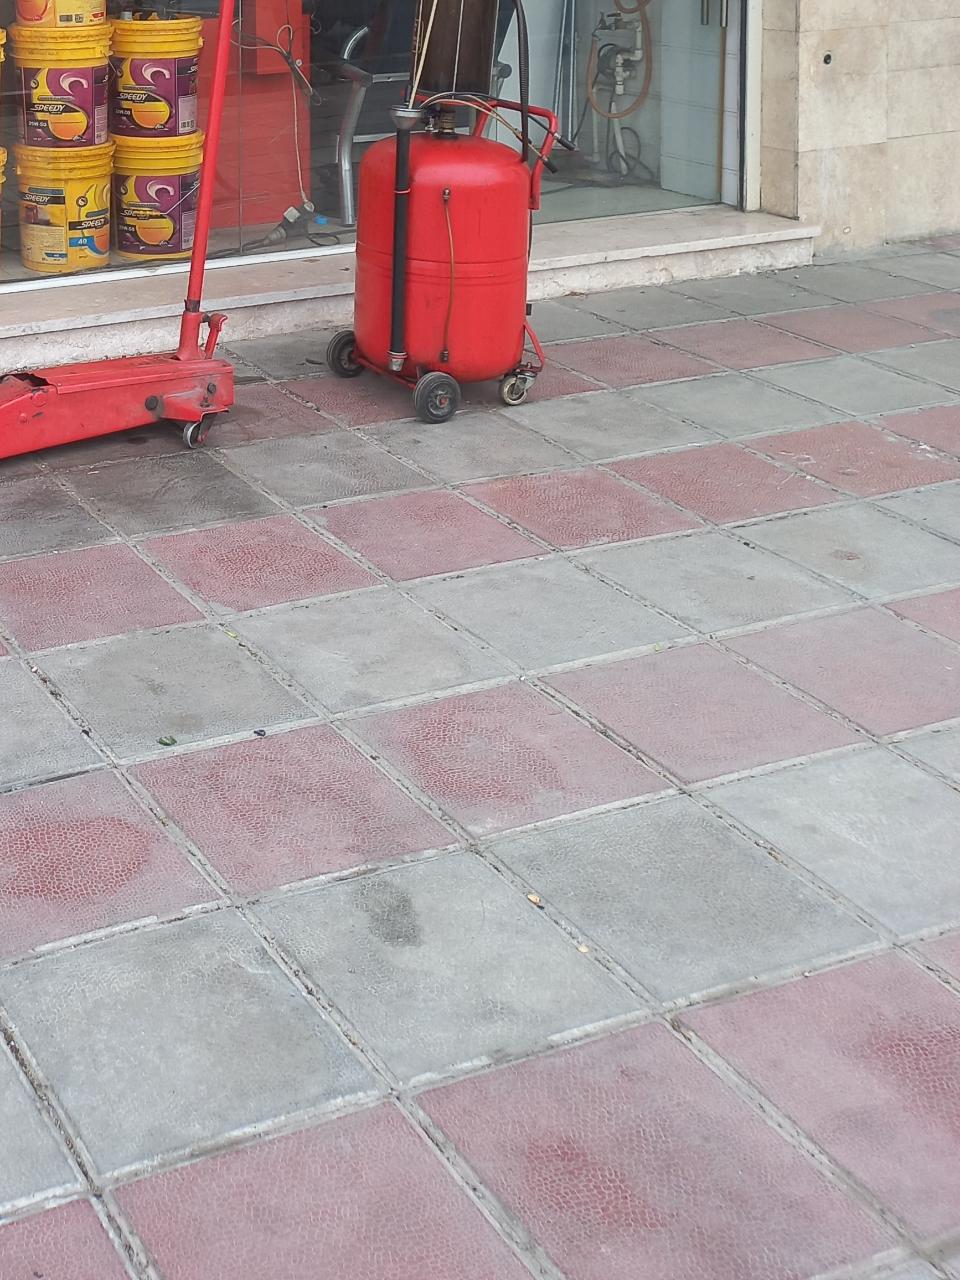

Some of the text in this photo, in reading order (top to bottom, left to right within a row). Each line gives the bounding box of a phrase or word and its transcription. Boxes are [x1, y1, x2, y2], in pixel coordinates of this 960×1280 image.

[117, 92, 148, 101] SPEEDY
[30, 104, 66, 112] SPEEDY
[24, 194, 50, 203] SPEEDY
